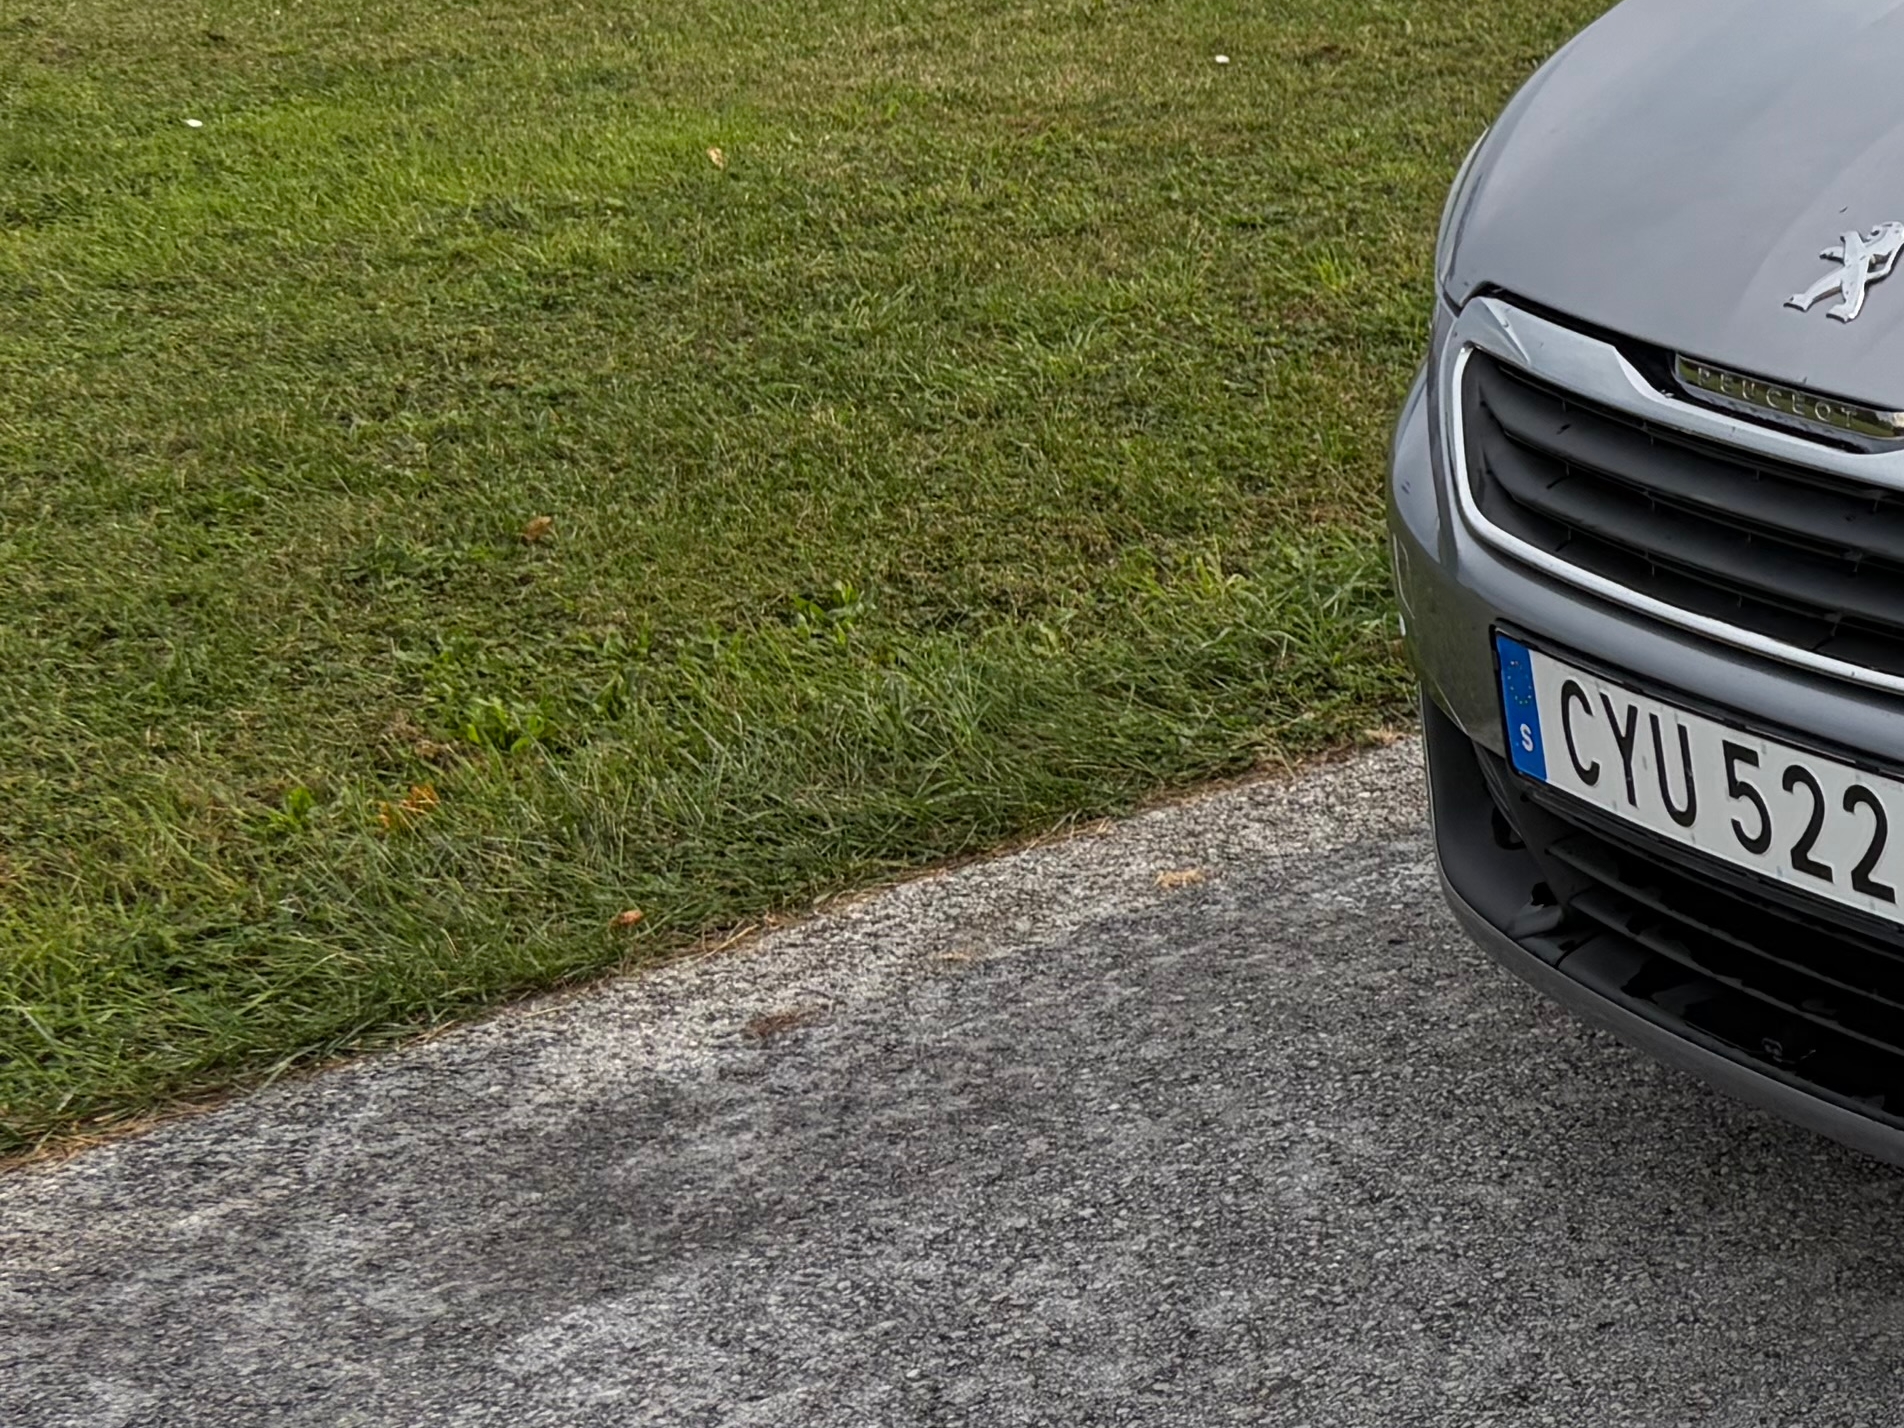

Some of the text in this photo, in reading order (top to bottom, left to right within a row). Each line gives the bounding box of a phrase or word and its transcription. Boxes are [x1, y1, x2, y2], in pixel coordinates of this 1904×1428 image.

[1519, 723, 1534, 753] S
[1560, 679, 1896, 904] CYU 522
